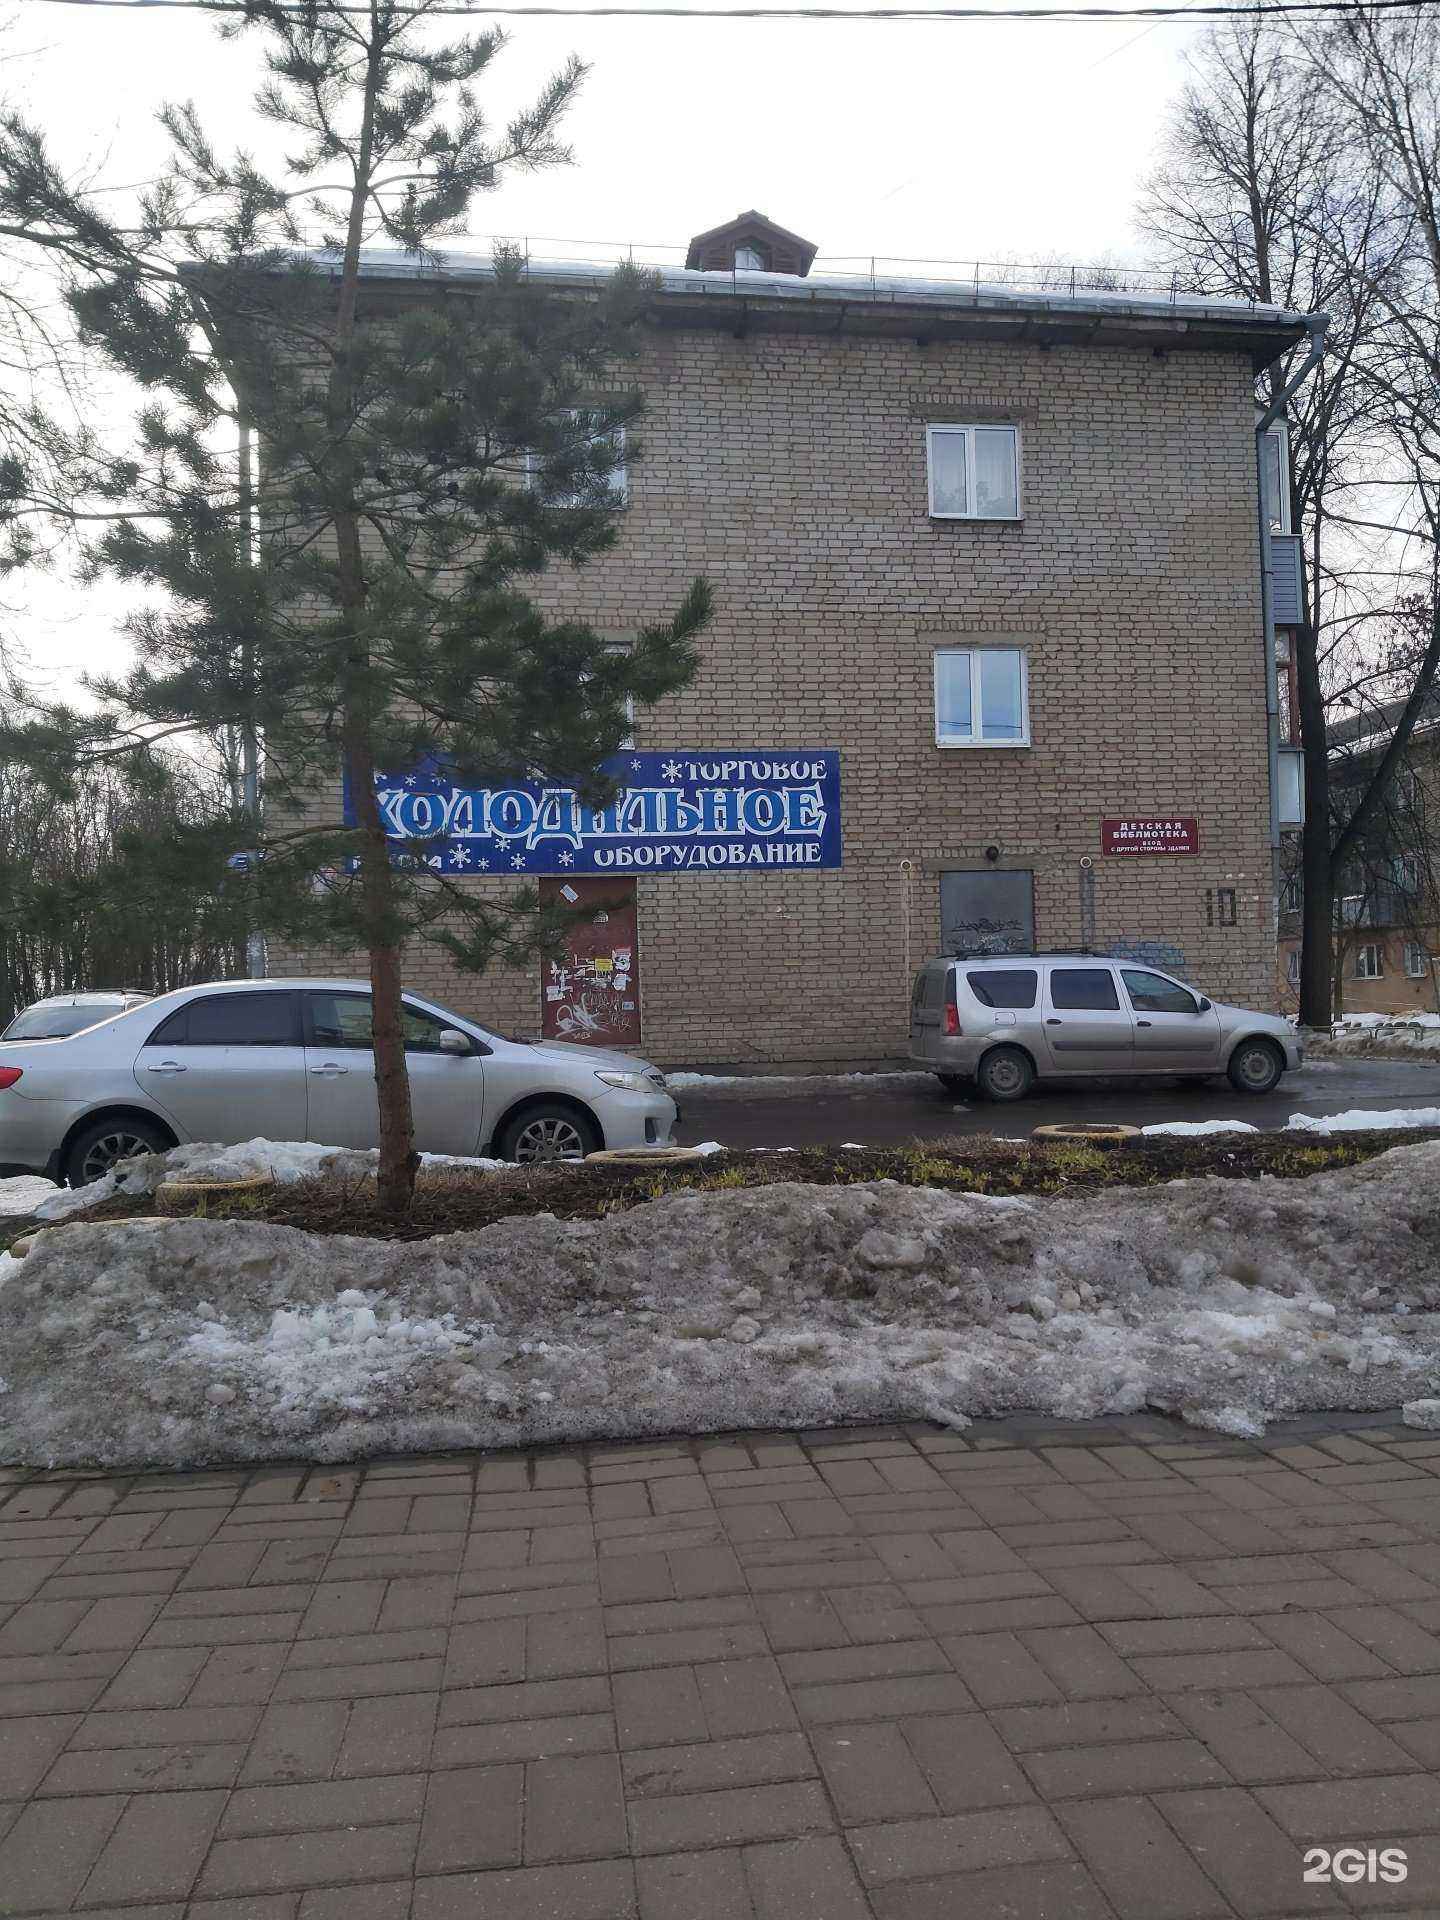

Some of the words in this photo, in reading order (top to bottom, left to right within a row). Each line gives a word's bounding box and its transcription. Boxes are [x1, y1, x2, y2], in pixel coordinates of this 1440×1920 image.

[684, 759, 828, 781] ТОРГОВОЕ
[1120, 822, 1182, 831] ДЕТСКАЯ
[1112, 830, 1188, 839] БИБЛИОТЕКА
[593, 843, 823, 869] ОБОРУДОВАНИЕ
